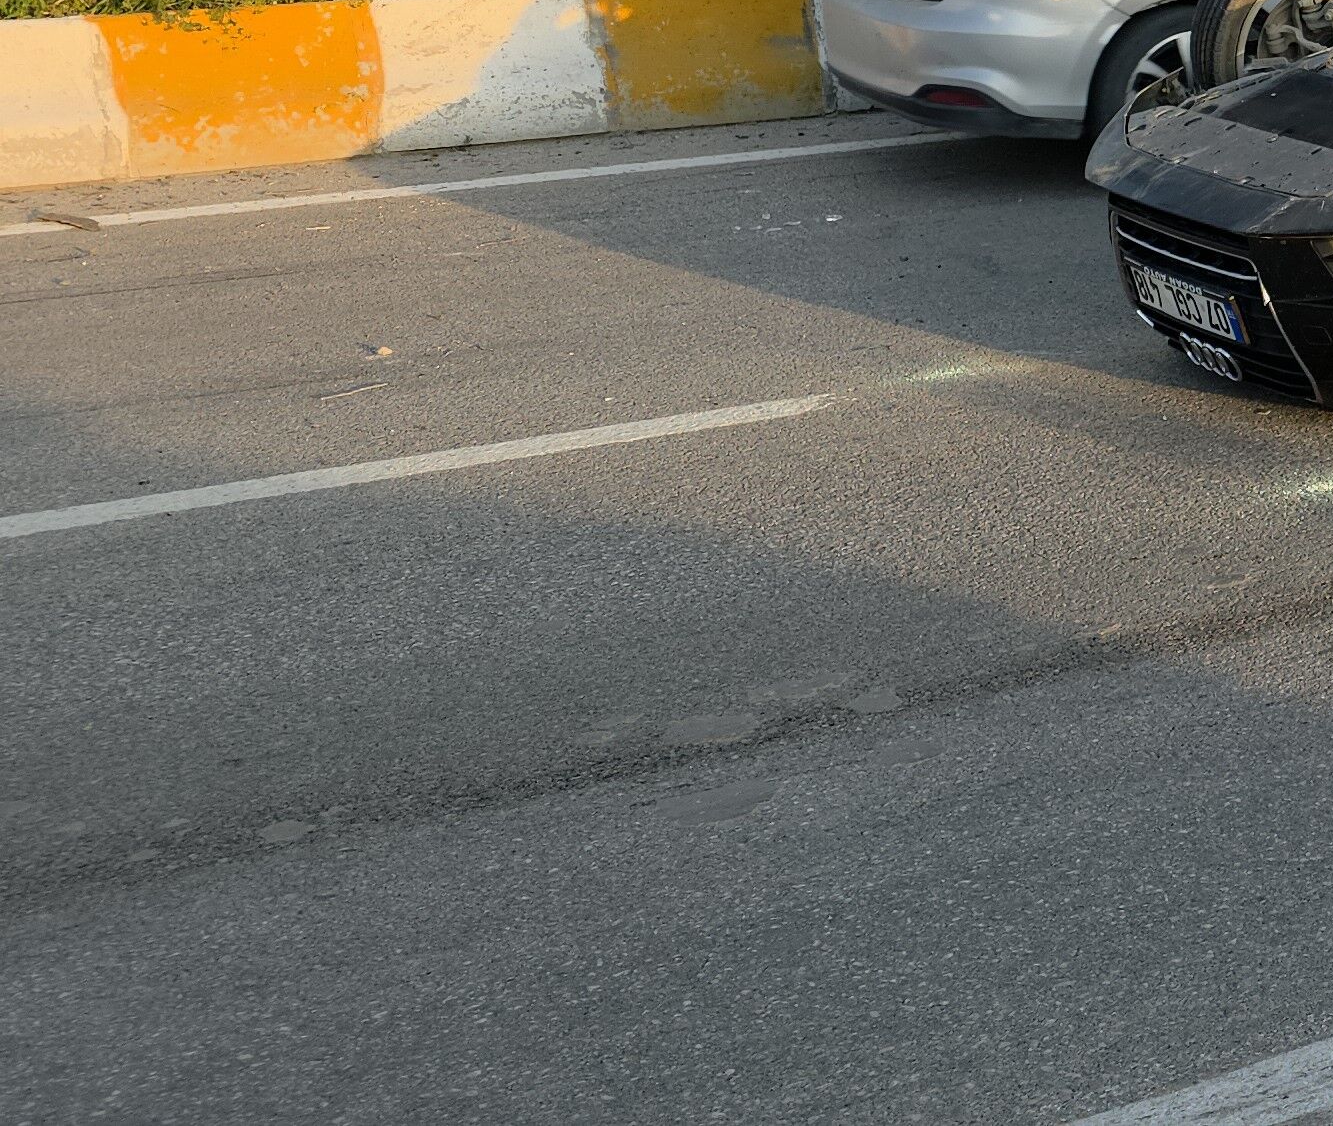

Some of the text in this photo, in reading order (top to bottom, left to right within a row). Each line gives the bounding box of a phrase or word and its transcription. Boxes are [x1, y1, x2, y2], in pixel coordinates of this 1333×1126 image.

[1133, 269, 1231, 334] 07 CGL 418
